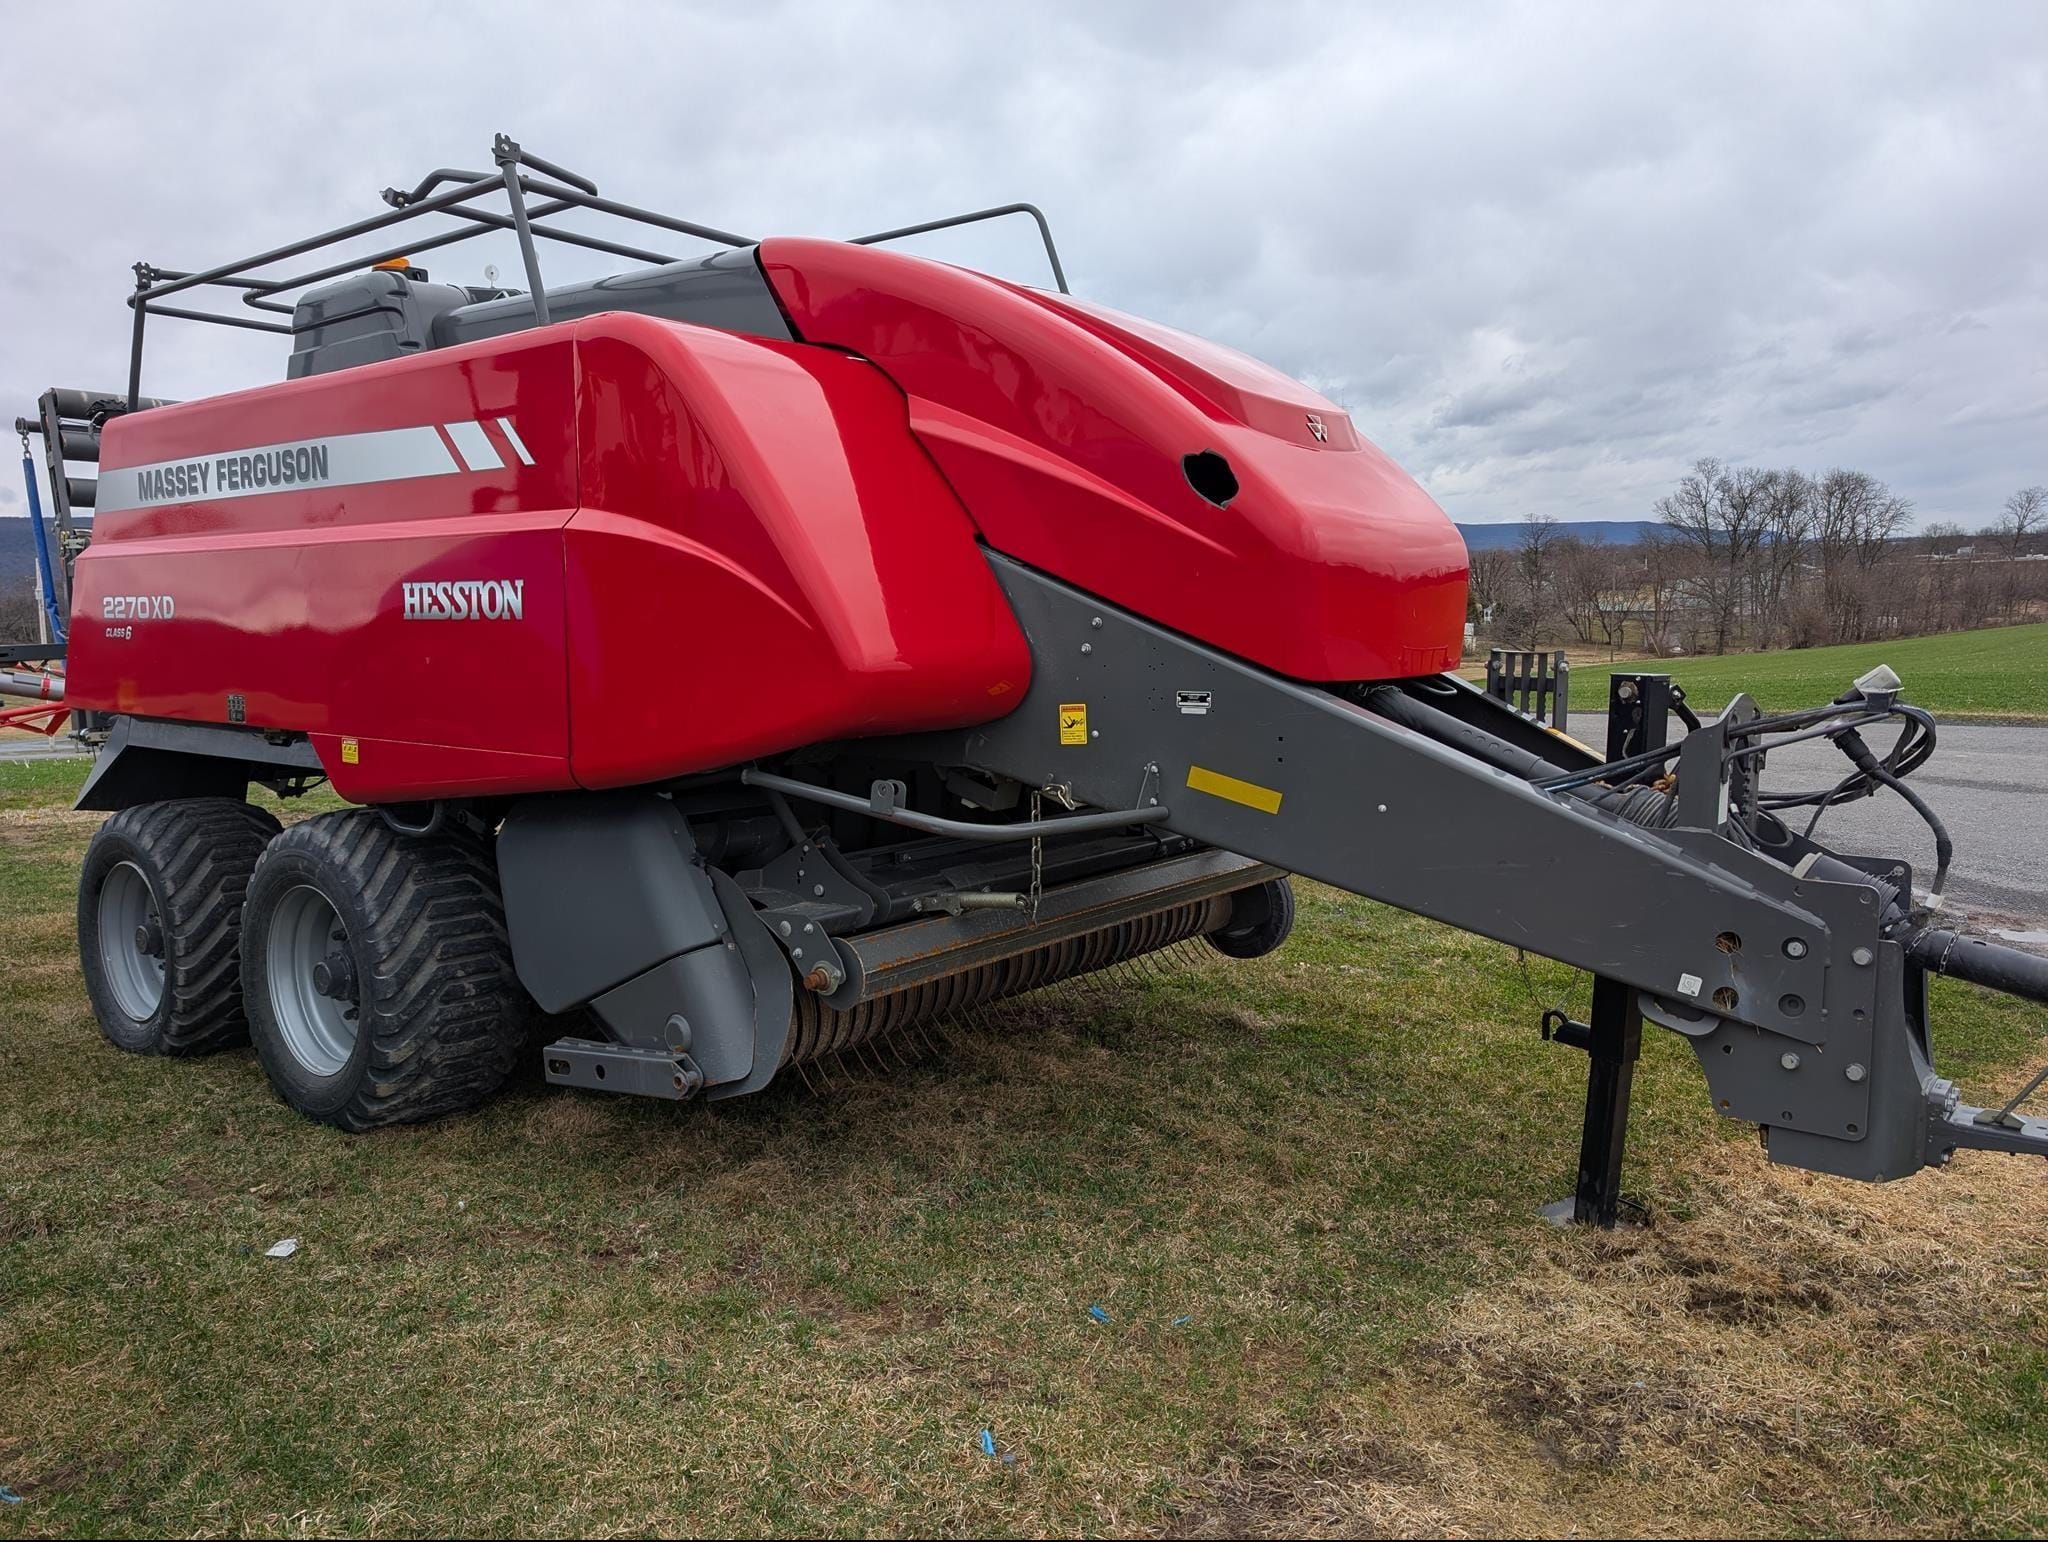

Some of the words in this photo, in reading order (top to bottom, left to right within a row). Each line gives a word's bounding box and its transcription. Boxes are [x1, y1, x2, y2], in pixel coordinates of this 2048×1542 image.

[138, 461, 210, 501] MASSEY
[216, 445, 329, 492] FERGUSON
[402, 579, 524, 620] HESSTON
